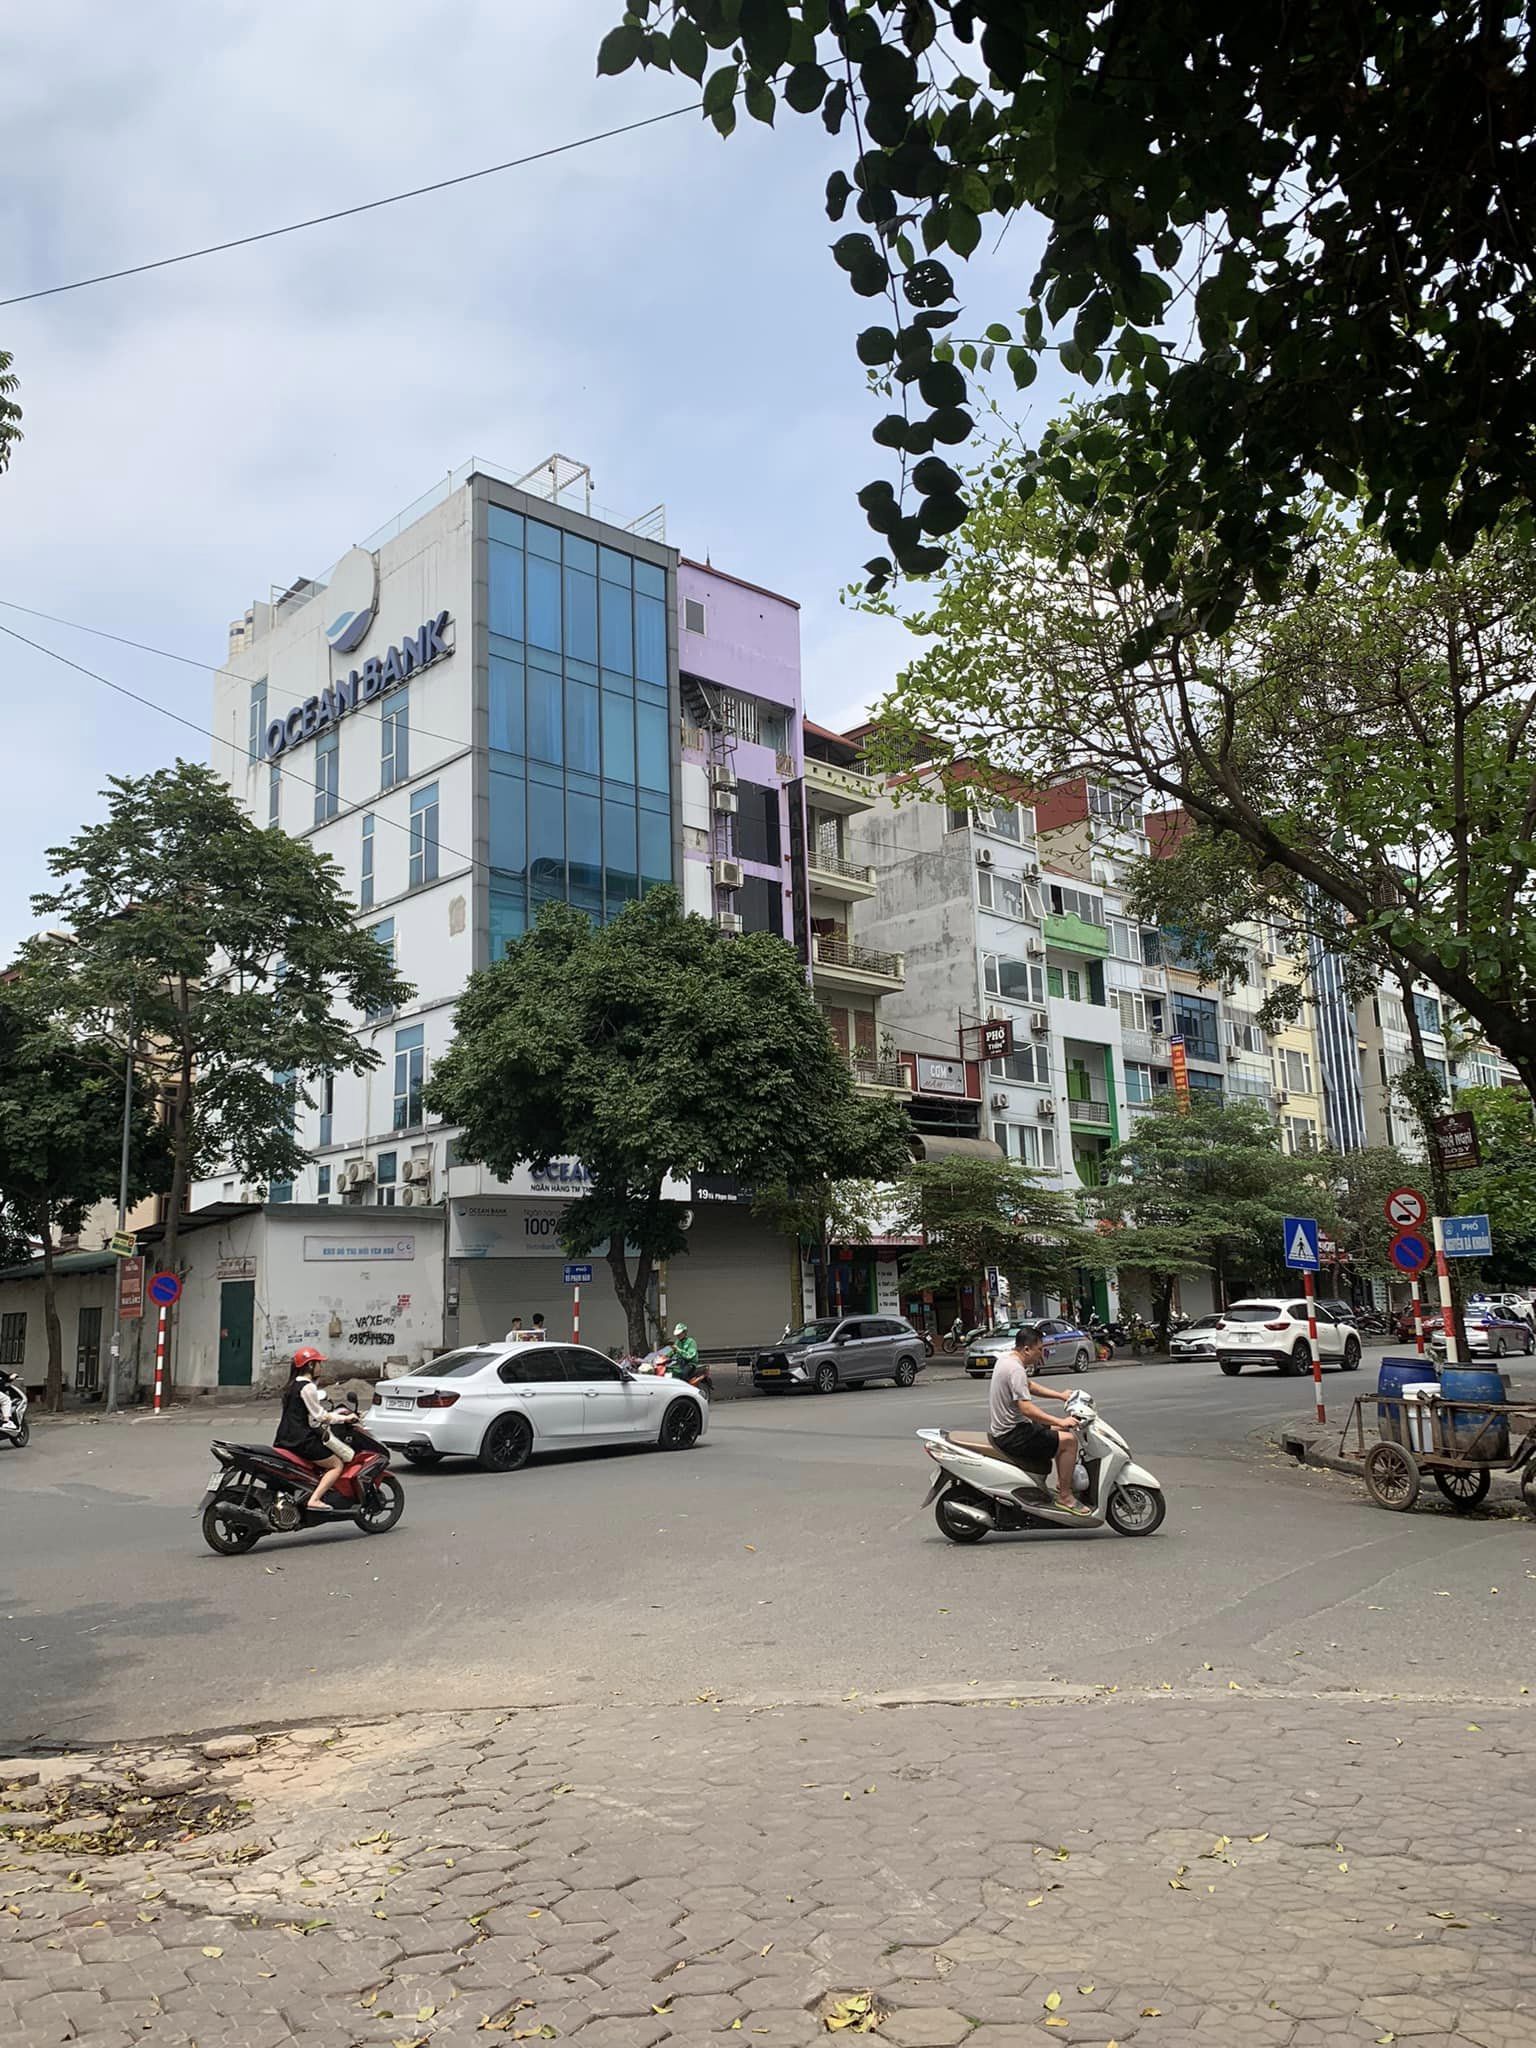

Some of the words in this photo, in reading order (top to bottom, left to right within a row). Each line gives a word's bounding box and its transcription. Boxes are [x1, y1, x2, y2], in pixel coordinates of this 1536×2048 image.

[265, 669, 360, 757] OCEAN
[362, 610, 451, 700] BANK
[985, 1026, 1006, 1042] PHỞ
[530, 1184, 549, 1192] NGÂN
[551, 1184, 570, 1193] HÀNG
[696, 1188, 709, 1200] 19
[1461, 1219, 1479, 1231] PHỐ
[990, 1273, 996, 1289] P
